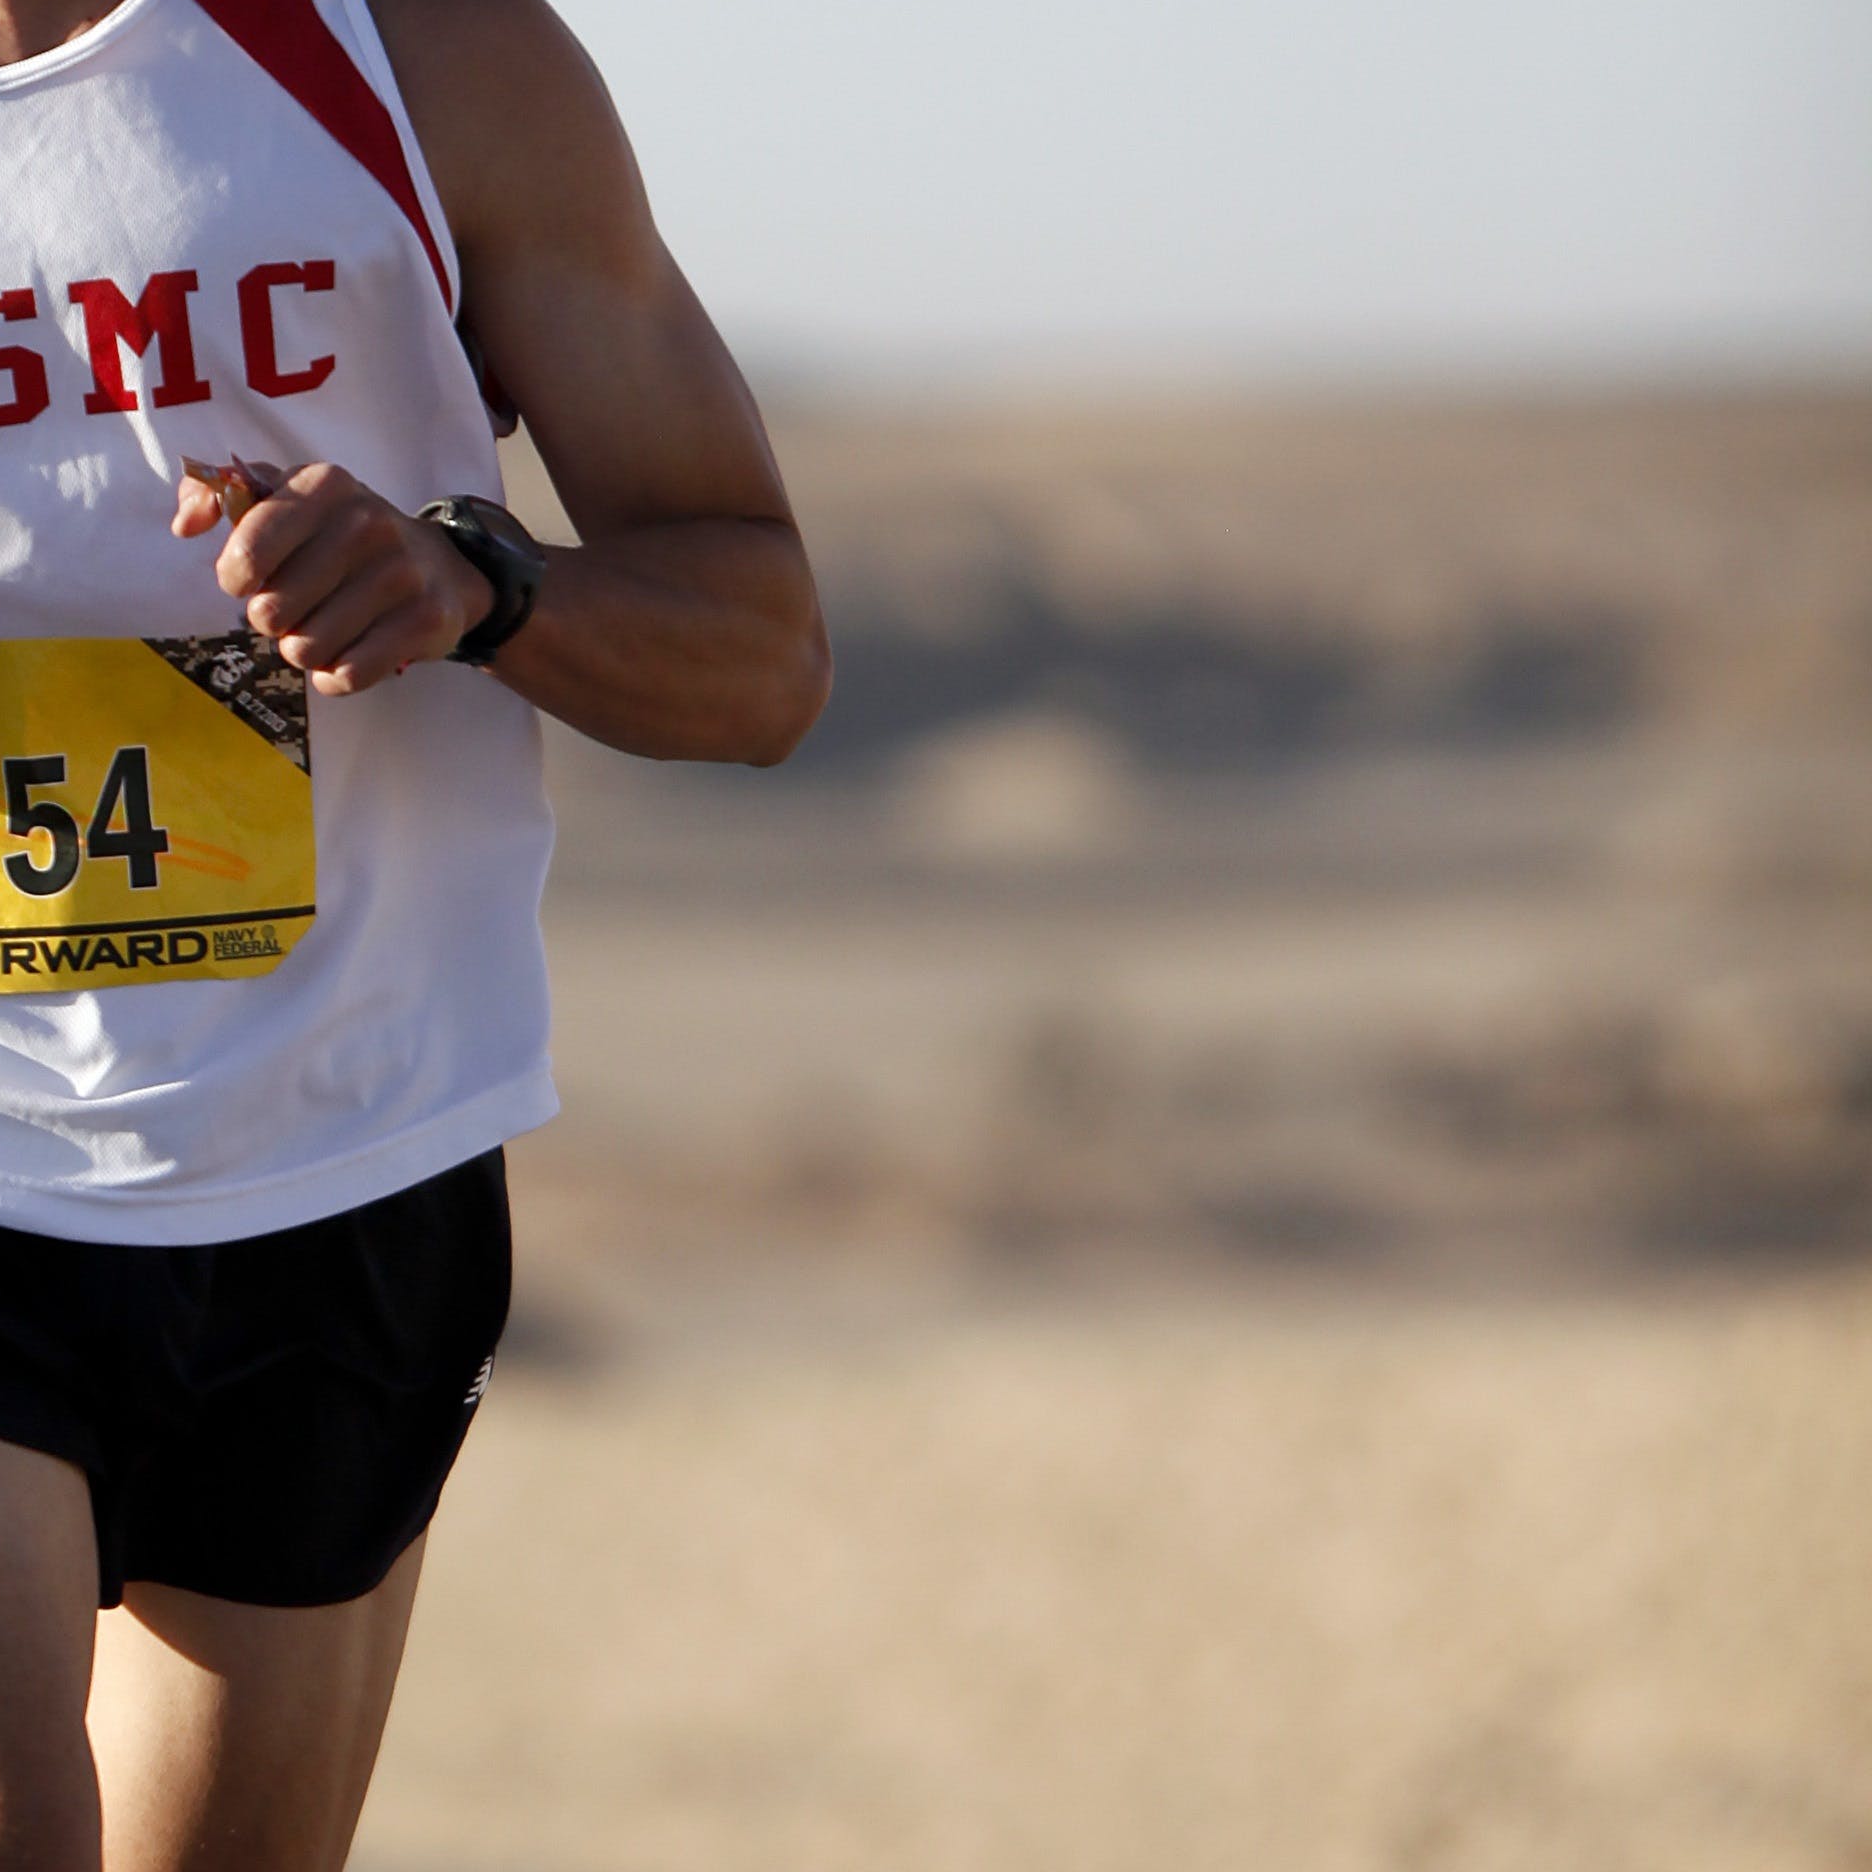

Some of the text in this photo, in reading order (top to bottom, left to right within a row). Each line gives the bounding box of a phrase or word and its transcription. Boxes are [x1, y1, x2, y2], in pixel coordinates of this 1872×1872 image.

[1, 745, 170, 898] 54
[213, 928, 256, 942] NAVY
[214, 939, 282, 957] FEDERAL
